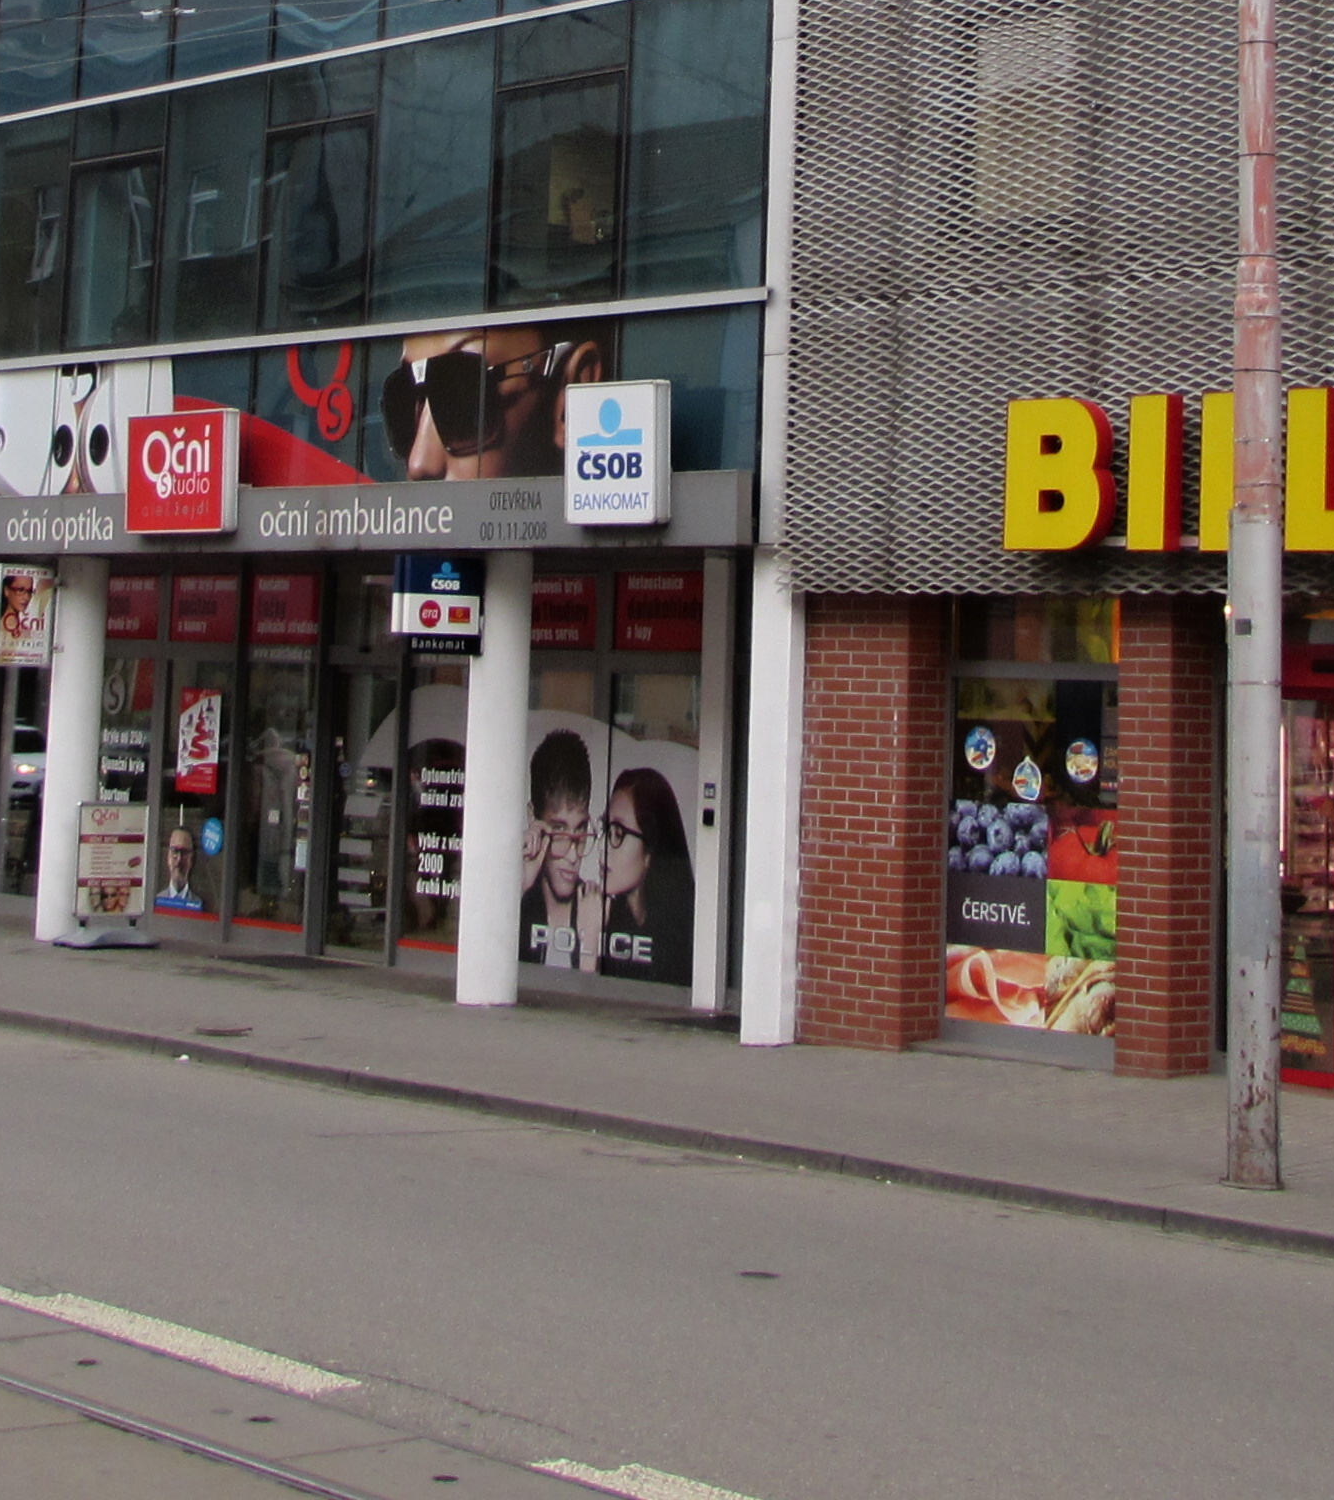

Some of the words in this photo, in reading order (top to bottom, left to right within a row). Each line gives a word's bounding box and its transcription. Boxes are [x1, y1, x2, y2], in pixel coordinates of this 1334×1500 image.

[142, 423, 211, 483] Oční
[576, 450, 643, 481] ČSOB
[489, 488, 543, 511] OTEVŘENA
[573, 491, 650, 511] BANKOMAT
[260, 500, 310, 537] oční
[315, 495, 454, 537] ambulance
[6, 505, 49, 543] oční
[50, 505, 114, 549] optika
[479, 522, 495, 541] OD
[497, 521, 548, 541] 1.11.2008
[431, 578, 461, 591] ČSOB
[627, 574, 684, 591] Meteostanice
[421, 609, 439, 619] era
[411, 637, 465, 650] Bankomat
[420, 789, 449, 807] měření
[449, 793, 465, 808] zra
[417, 831, 441, 851] Výběr
[418, 853, 444, 874] 2000
[416, 877, 441, 895] druhů
[961, 896, 1031, 926] ČERSTVÉ.
[530, 924, 653, 962] POLICE
